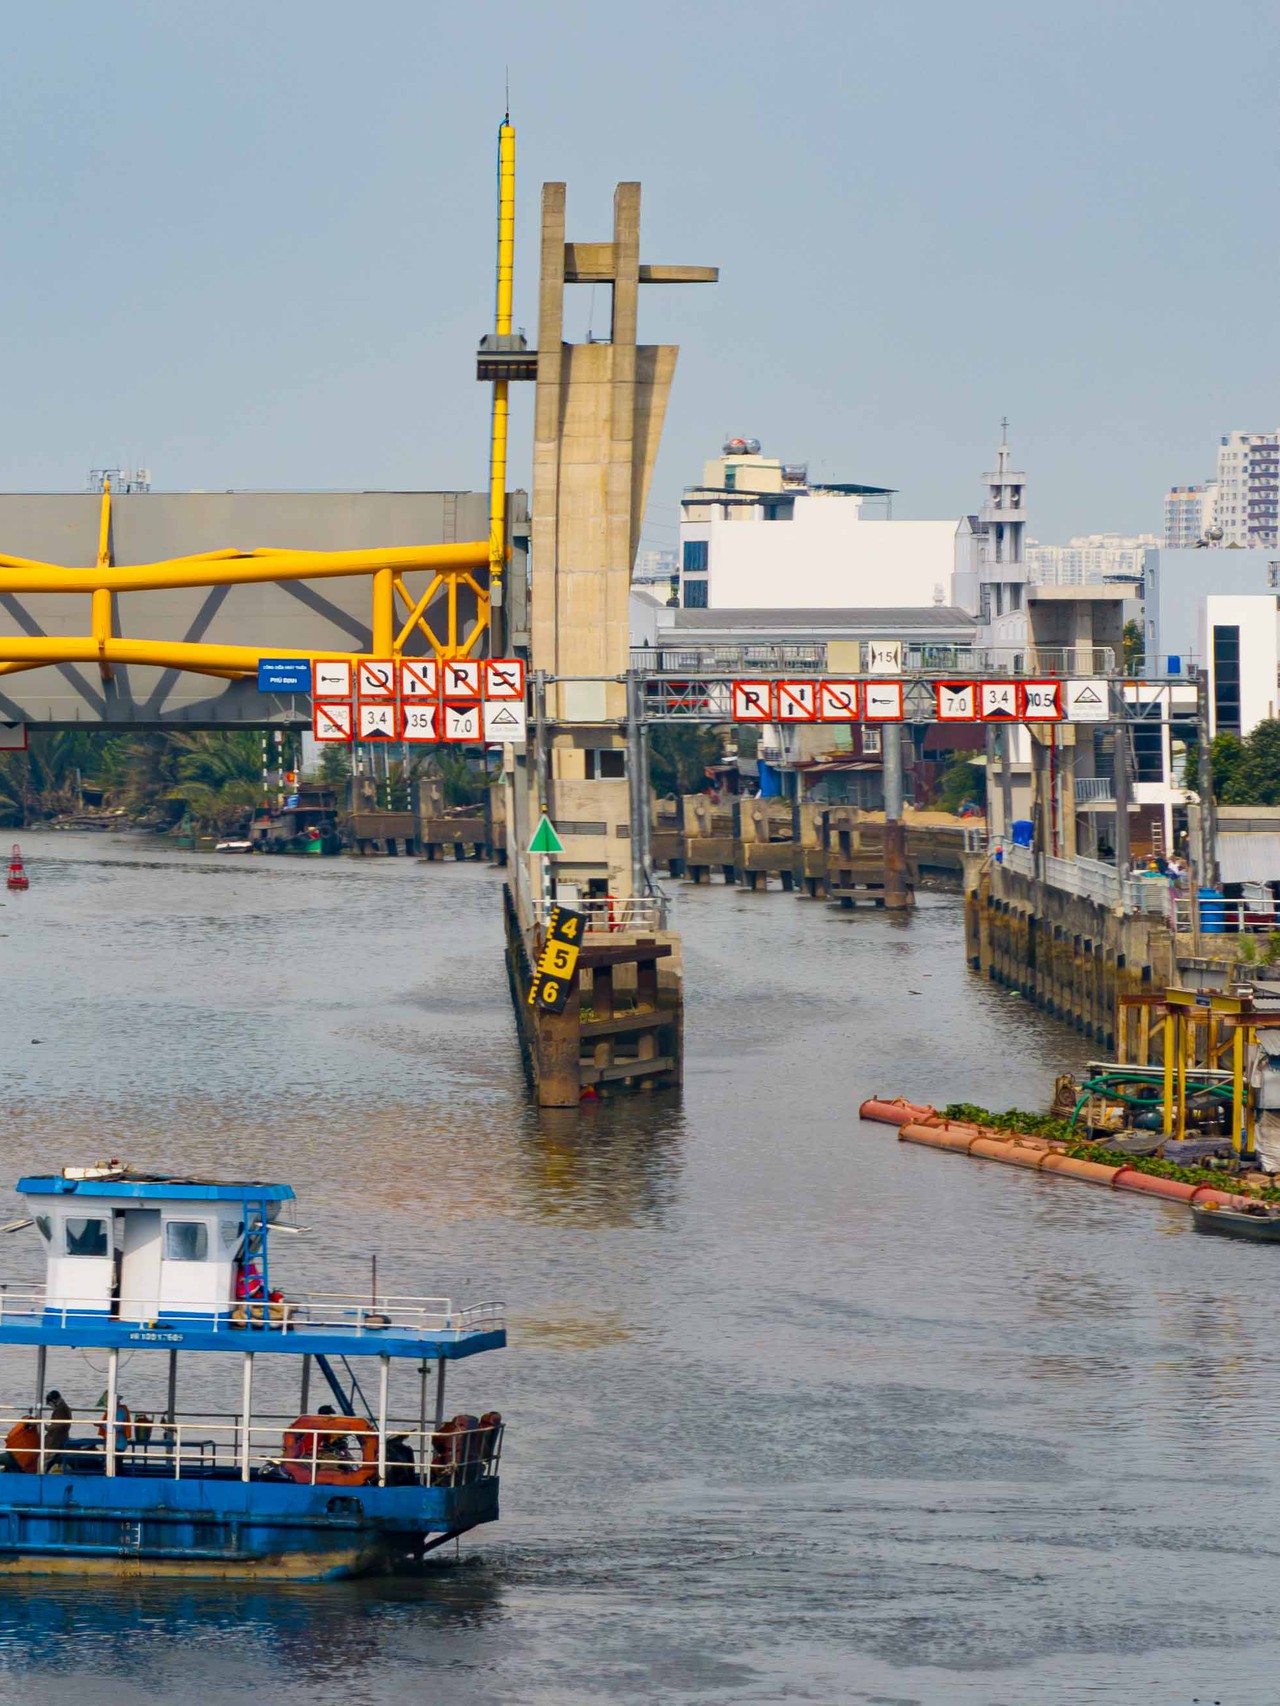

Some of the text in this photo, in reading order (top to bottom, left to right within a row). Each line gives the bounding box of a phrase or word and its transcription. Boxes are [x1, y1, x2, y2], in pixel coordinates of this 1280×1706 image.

[877, 651, 893, 663] 15
[454, 669, 469, 688] P
[745, 691, 759, 710] P
[989, 690, 1008, 703] 3.4
[1028, 692, 1052, 708] 10.5
[947, 698, 967, 712] 7.0
[367, 711, 387, 725] 3.4
[411, 713, 428, 728] 35
[452, 719, 473, 733] 7.0
[561, 918, 578, 938] 4
[553, 949, 569, 969] 5
[543, 982, 559, 1002] 6
